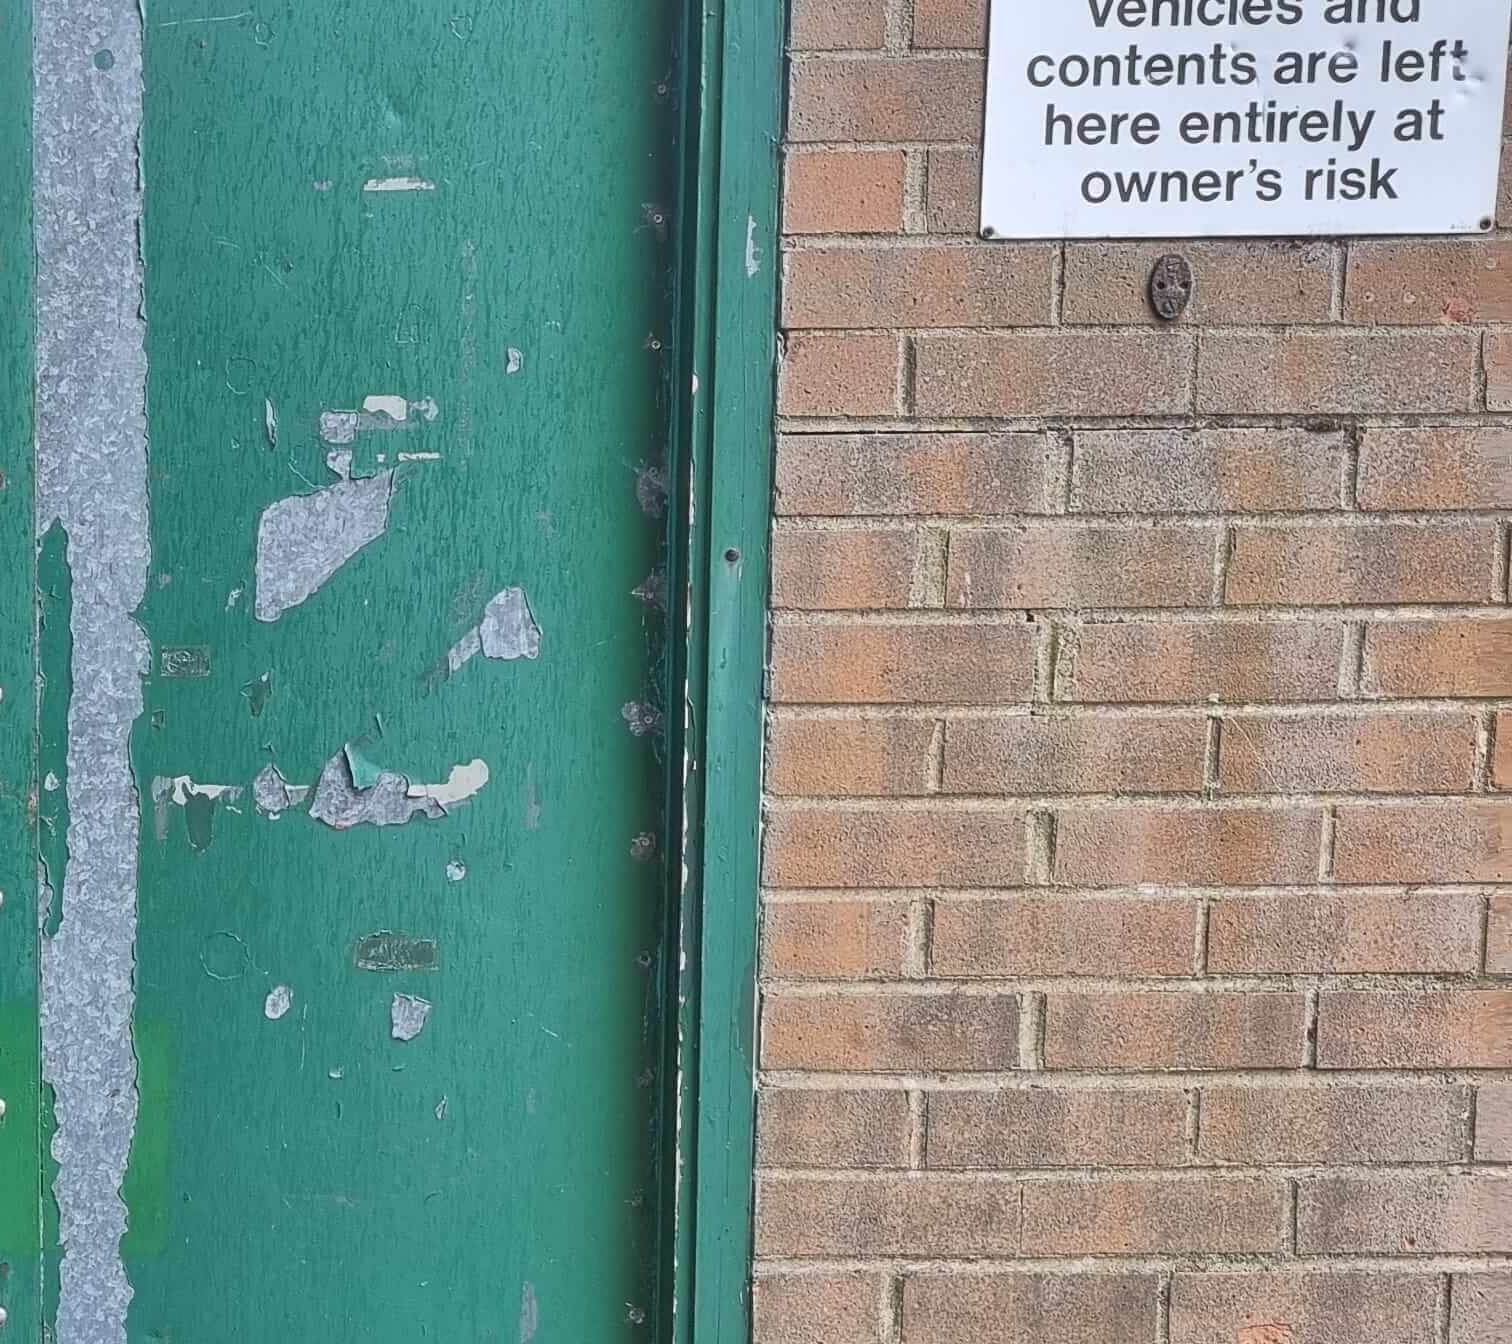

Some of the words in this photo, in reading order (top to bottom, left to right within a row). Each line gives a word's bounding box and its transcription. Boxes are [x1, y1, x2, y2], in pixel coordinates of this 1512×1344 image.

[1027, 44, 1256, 87] contents
[1274, 52, 1357, 84] are
[1381, 40, 1468, 82] left
[1046, 104, 1160, 145] here
[1180, 100, 1376, 151] entirely
[1394, 100, 1444, 141] at
[1082, 159, 1281, 203] owner's
[1306, 158, 1397, 200] risk
